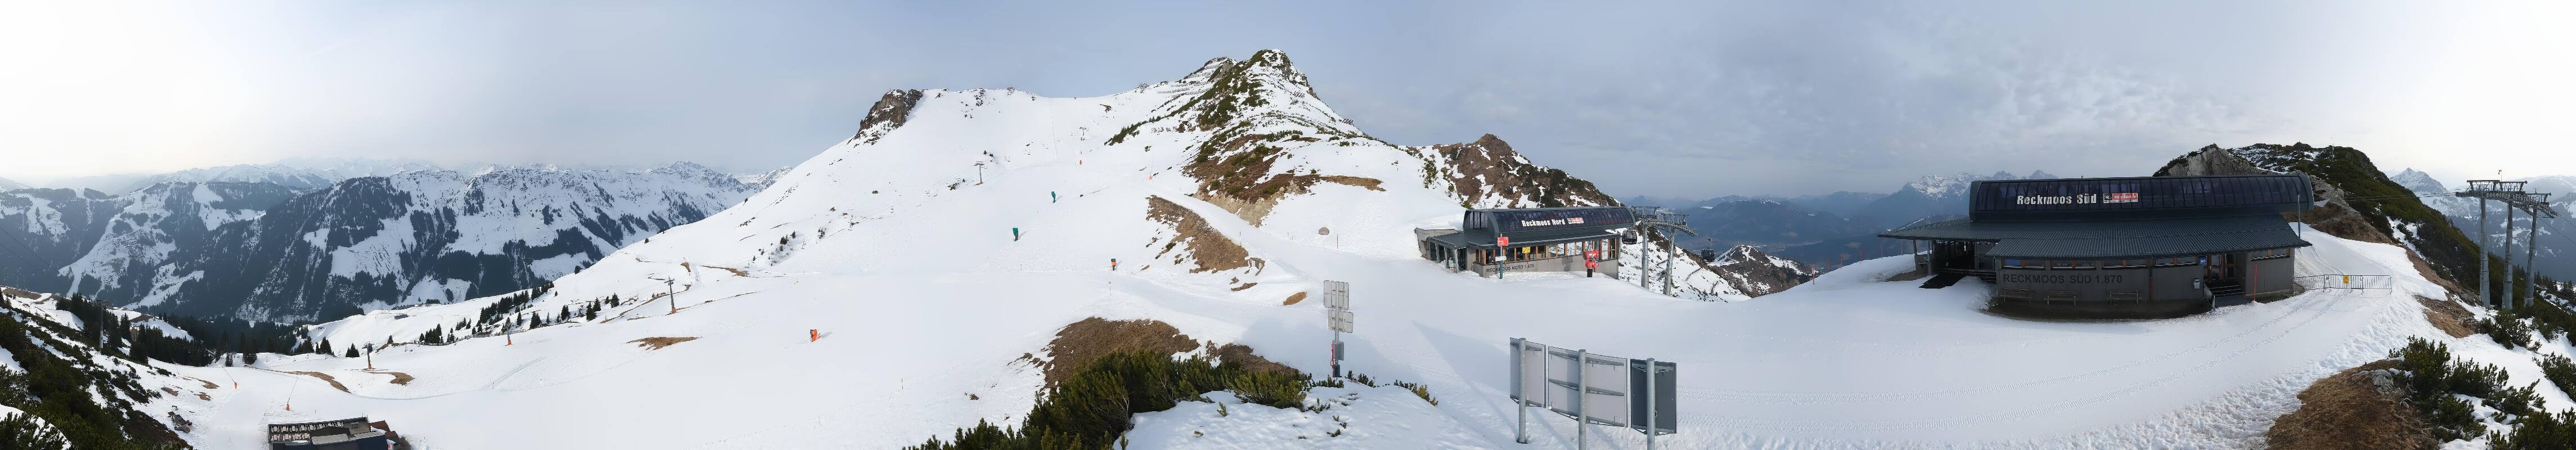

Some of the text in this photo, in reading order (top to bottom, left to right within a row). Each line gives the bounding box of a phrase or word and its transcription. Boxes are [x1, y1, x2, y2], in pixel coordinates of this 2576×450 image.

[2017, 193, 2097, 205] Reckmoos Süd
[2003, 273, 2122, 284] RECKMOOS SÜD 1.870
